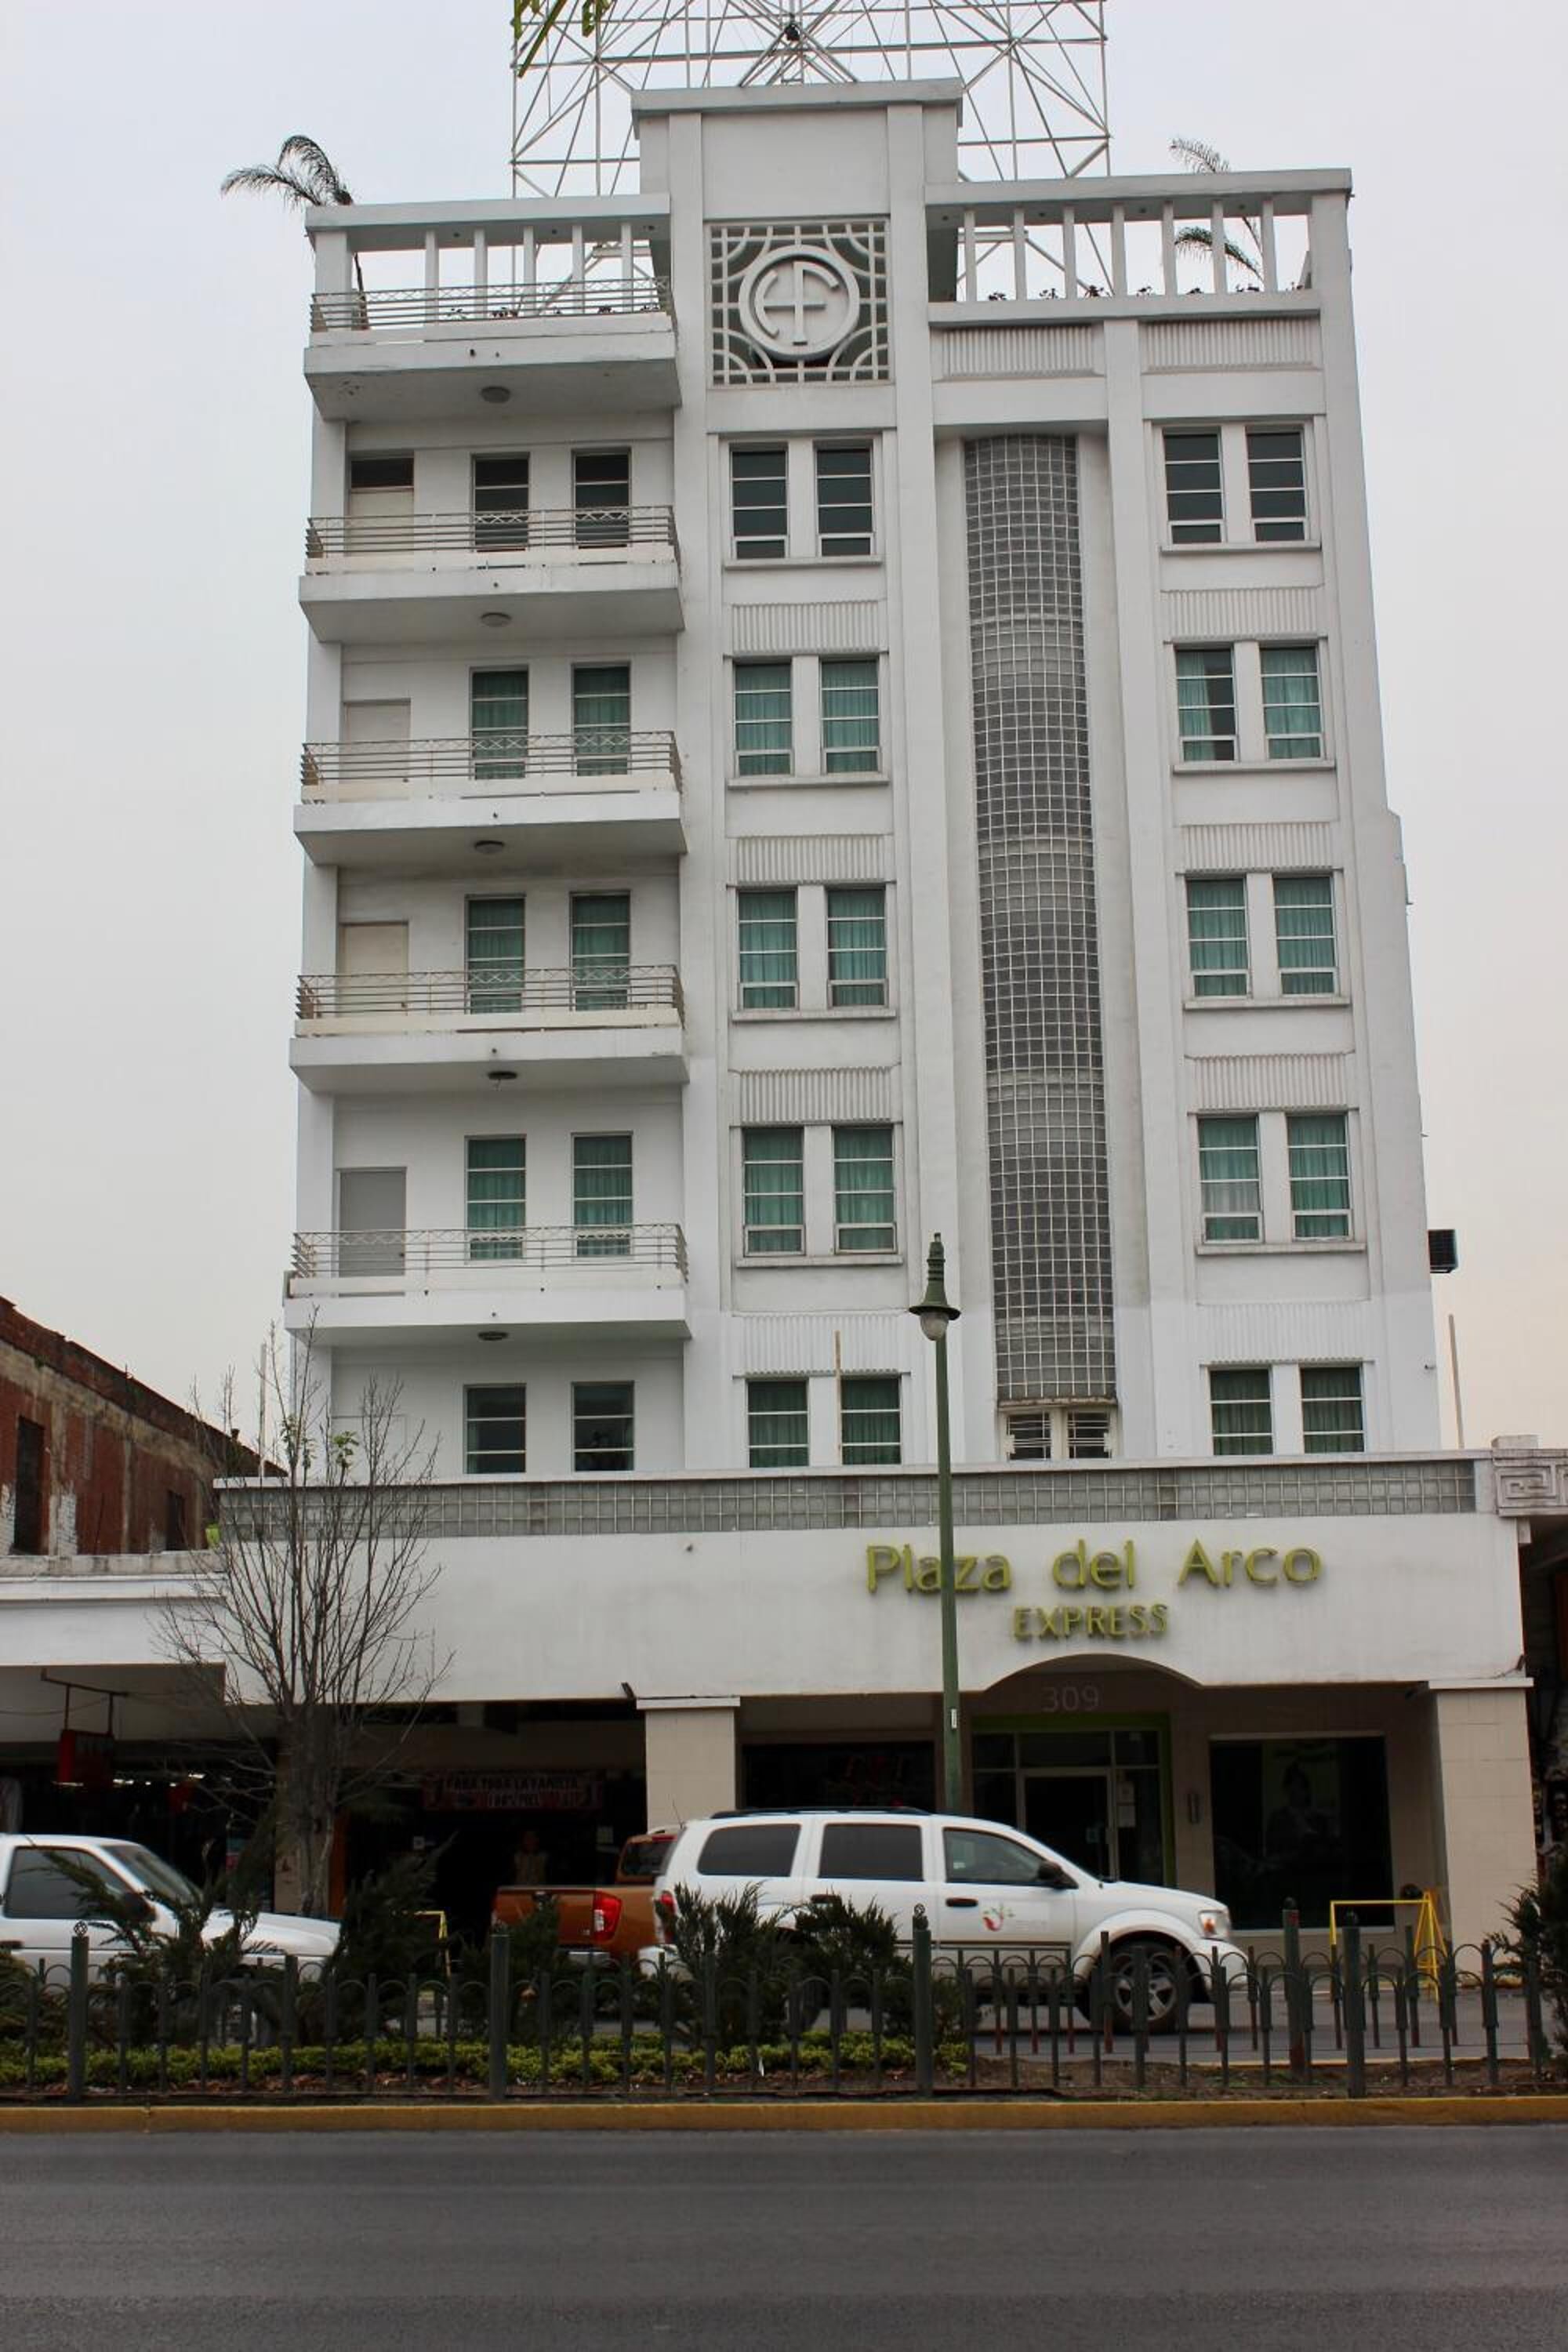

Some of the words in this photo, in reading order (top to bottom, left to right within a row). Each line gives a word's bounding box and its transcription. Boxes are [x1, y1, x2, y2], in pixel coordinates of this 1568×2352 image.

[866, 1544, 1012, 1594] Plaza
[1051, 1539, 1135, 1590] del
[1178, 1538, 1322, 1588] Arco
[1012, 1603, 1169, 1640] EXPRESS
[1040, 1686, 1099, 1712] 309
